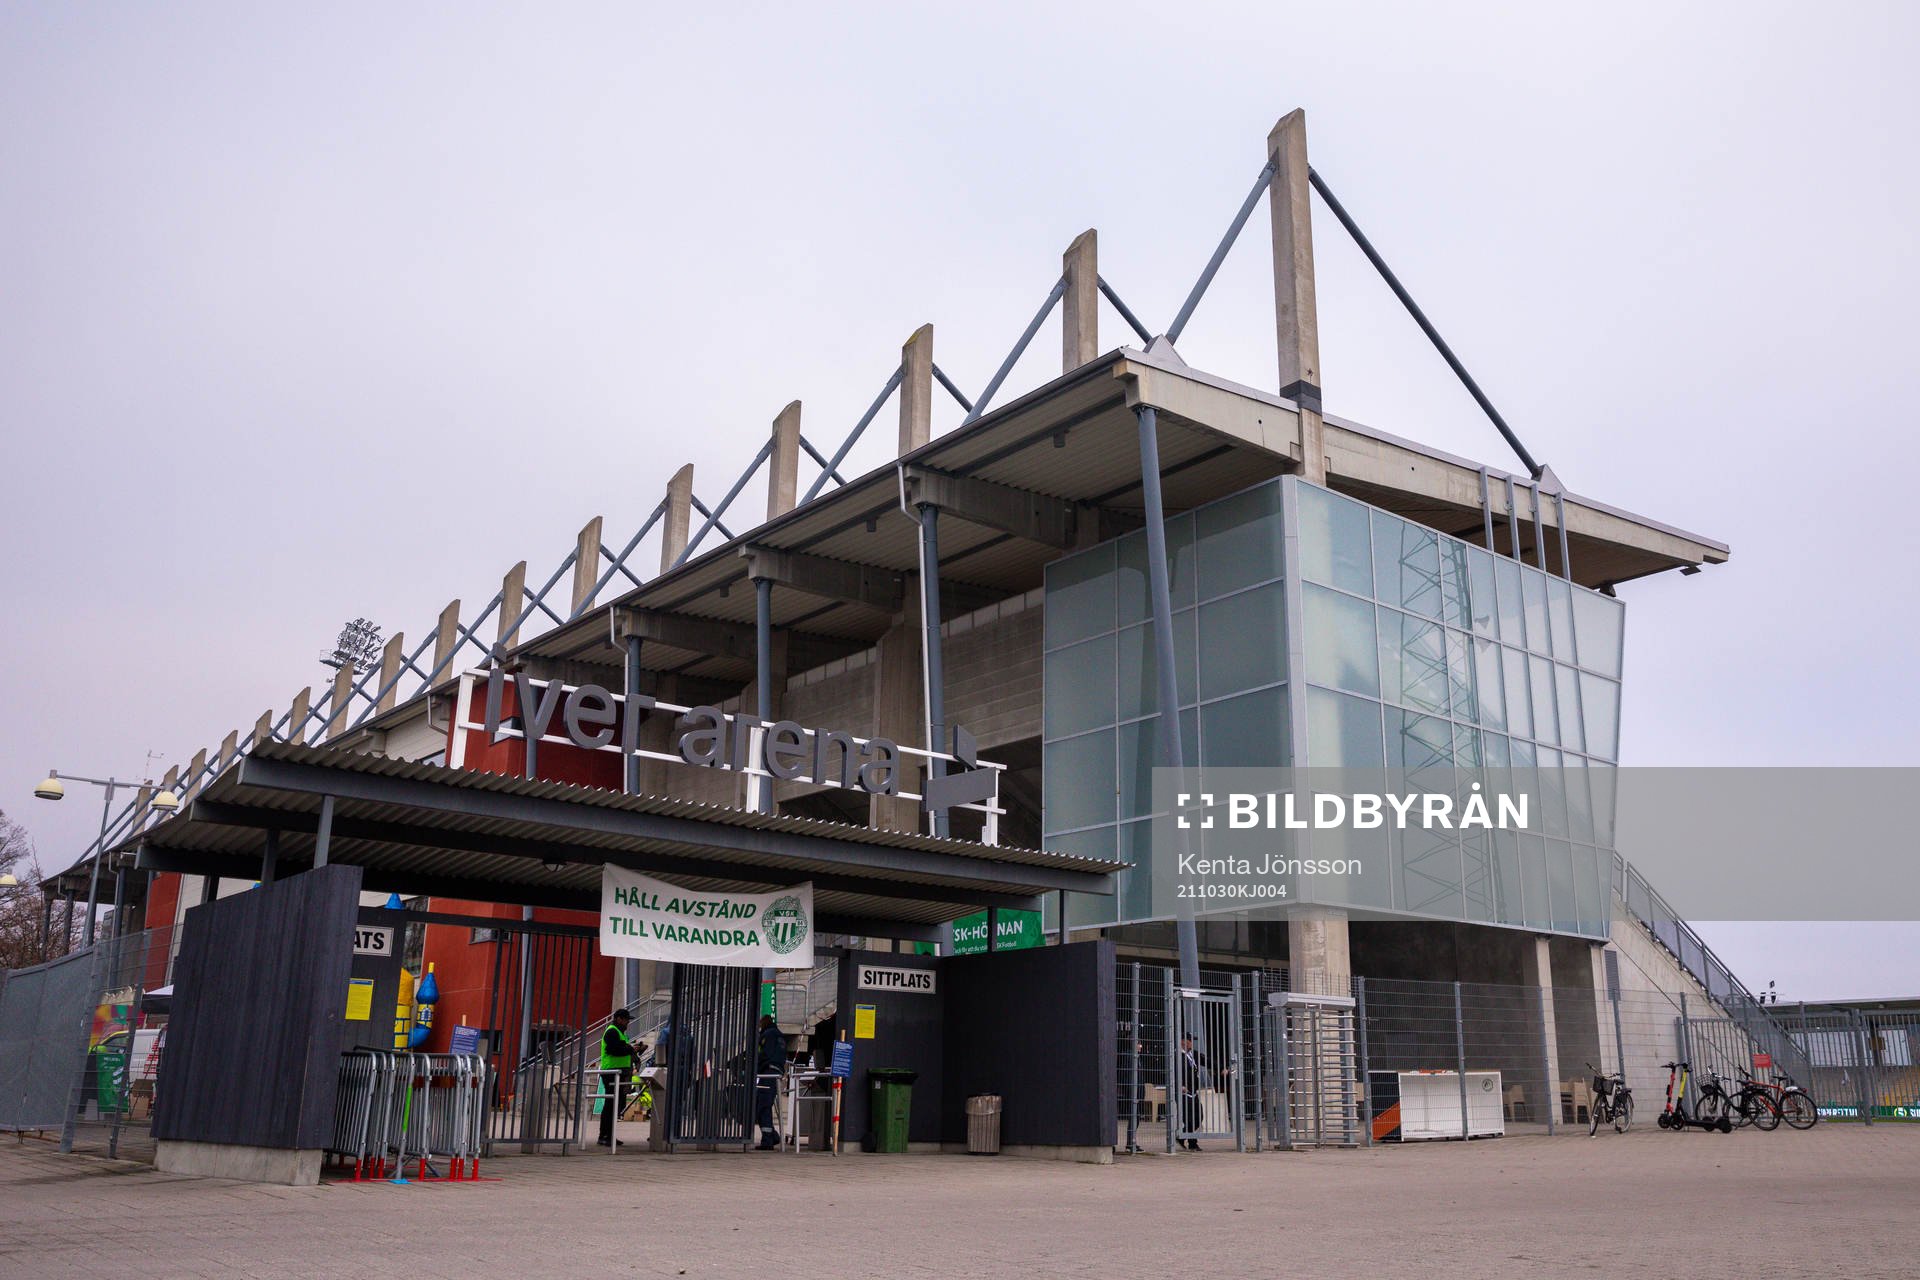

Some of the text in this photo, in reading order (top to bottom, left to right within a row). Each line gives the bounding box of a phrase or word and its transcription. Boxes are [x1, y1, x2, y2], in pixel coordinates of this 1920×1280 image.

[678, 705, 900, 796] arena
[614, 887, 757, 919] HÅLL AVSTÅND
[609, 916, 760, 946] TILL VARANDRA
[864, 970, 931, 989] SITTPLATS
